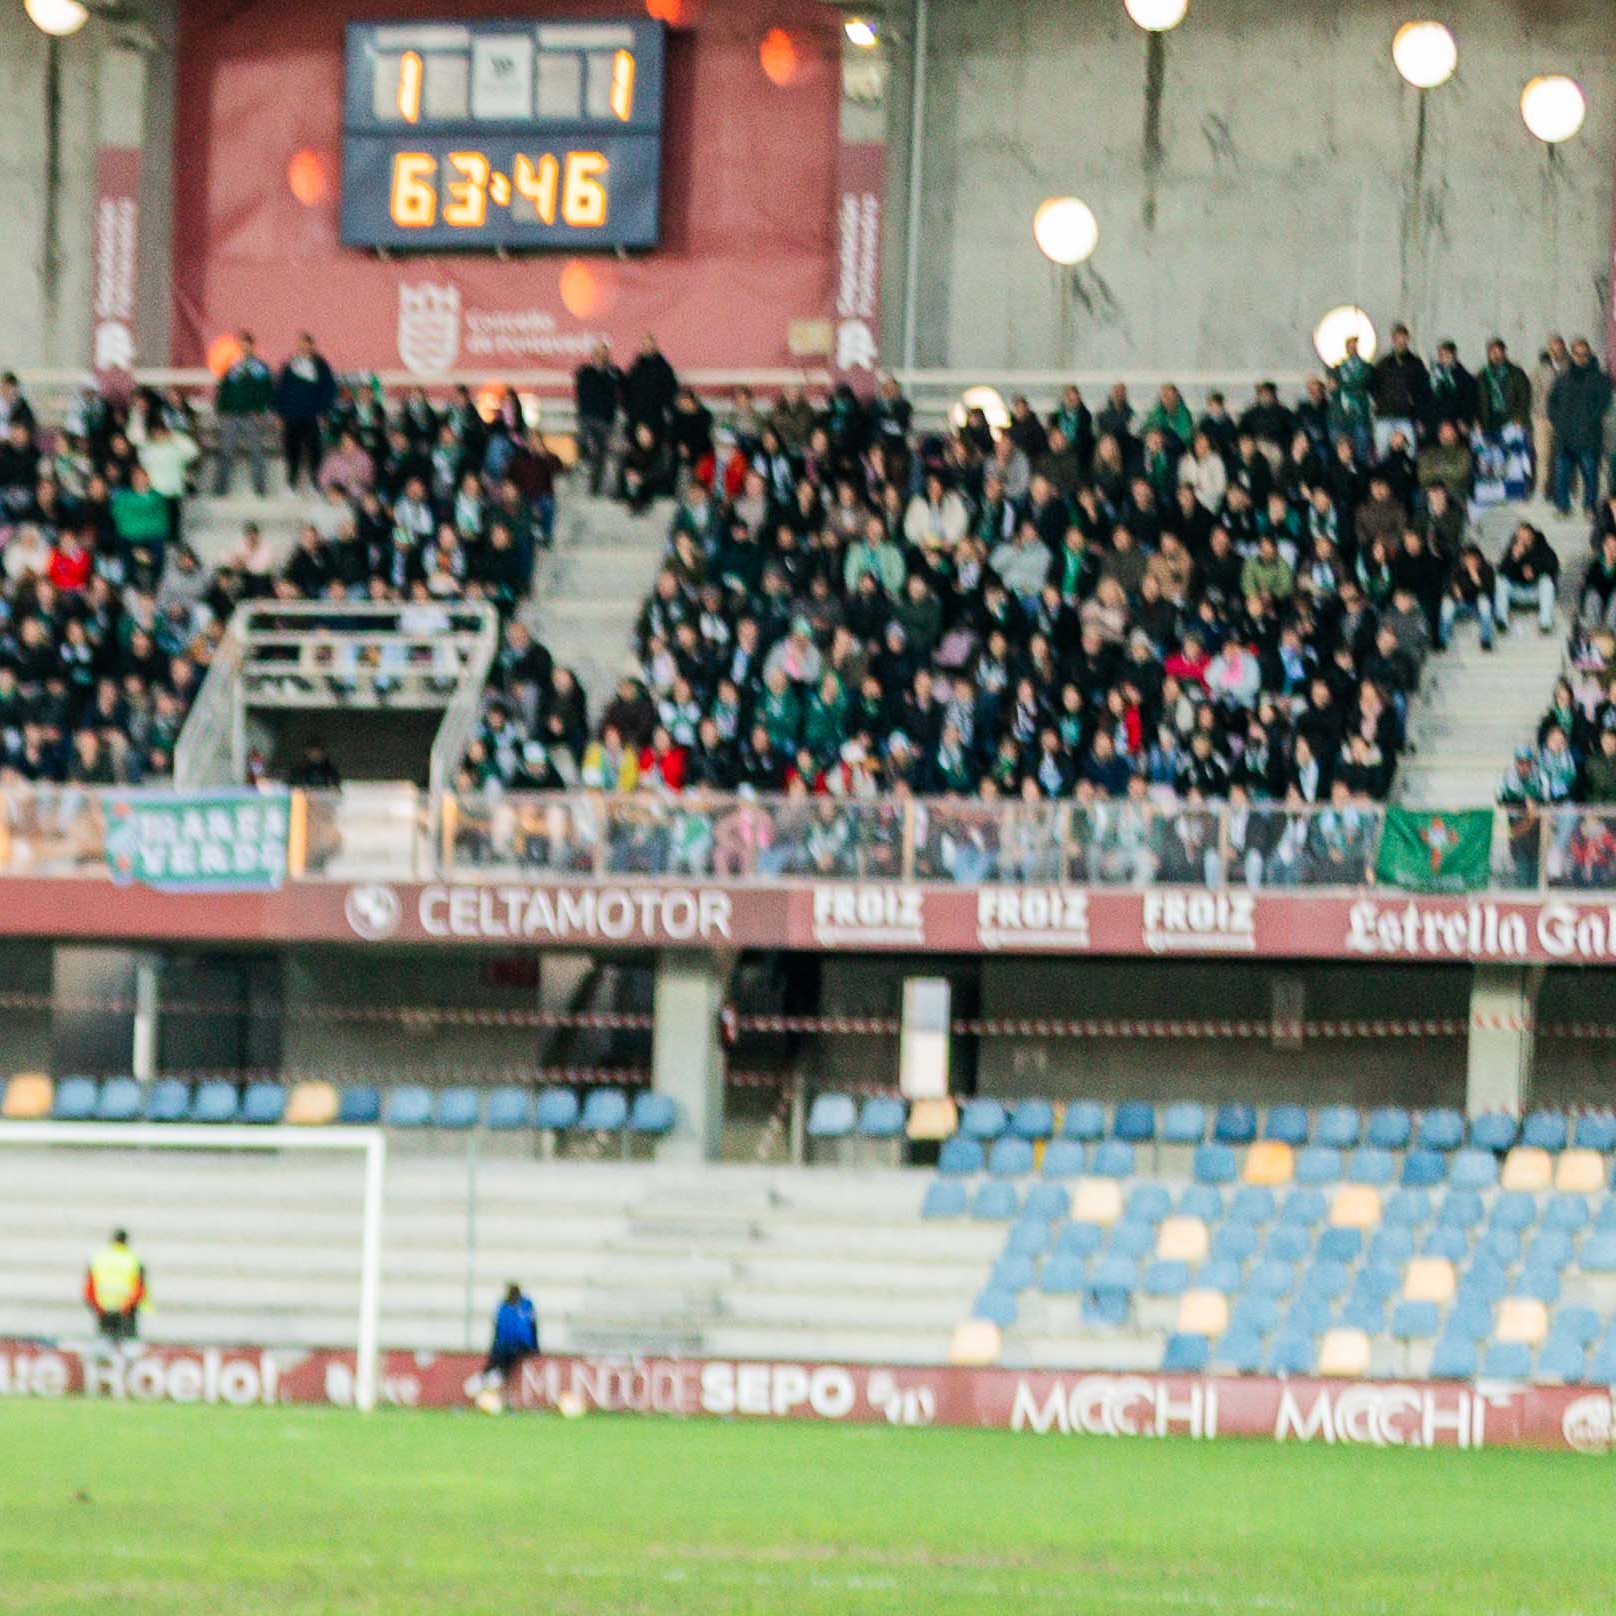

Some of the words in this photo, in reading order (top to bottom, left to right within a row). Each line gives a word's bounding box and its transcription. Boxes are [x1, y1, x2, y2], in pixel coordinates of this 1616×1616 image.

[399, 50, 423, 123] 1
[610, 48, 635, 122] 1
[390, 150, 609, 228] 63:46
[418, 886, 732, 940] CELTAMOTOR
[813, 885, 924, 929] FROIZ
[978, 888, 1089, 932] FROIZ
[1143, 890, 1254, 934] FROIZ
[1345, 898, 1528, 954] Estrella
[699, 1361, 856, 1418] SEPO
